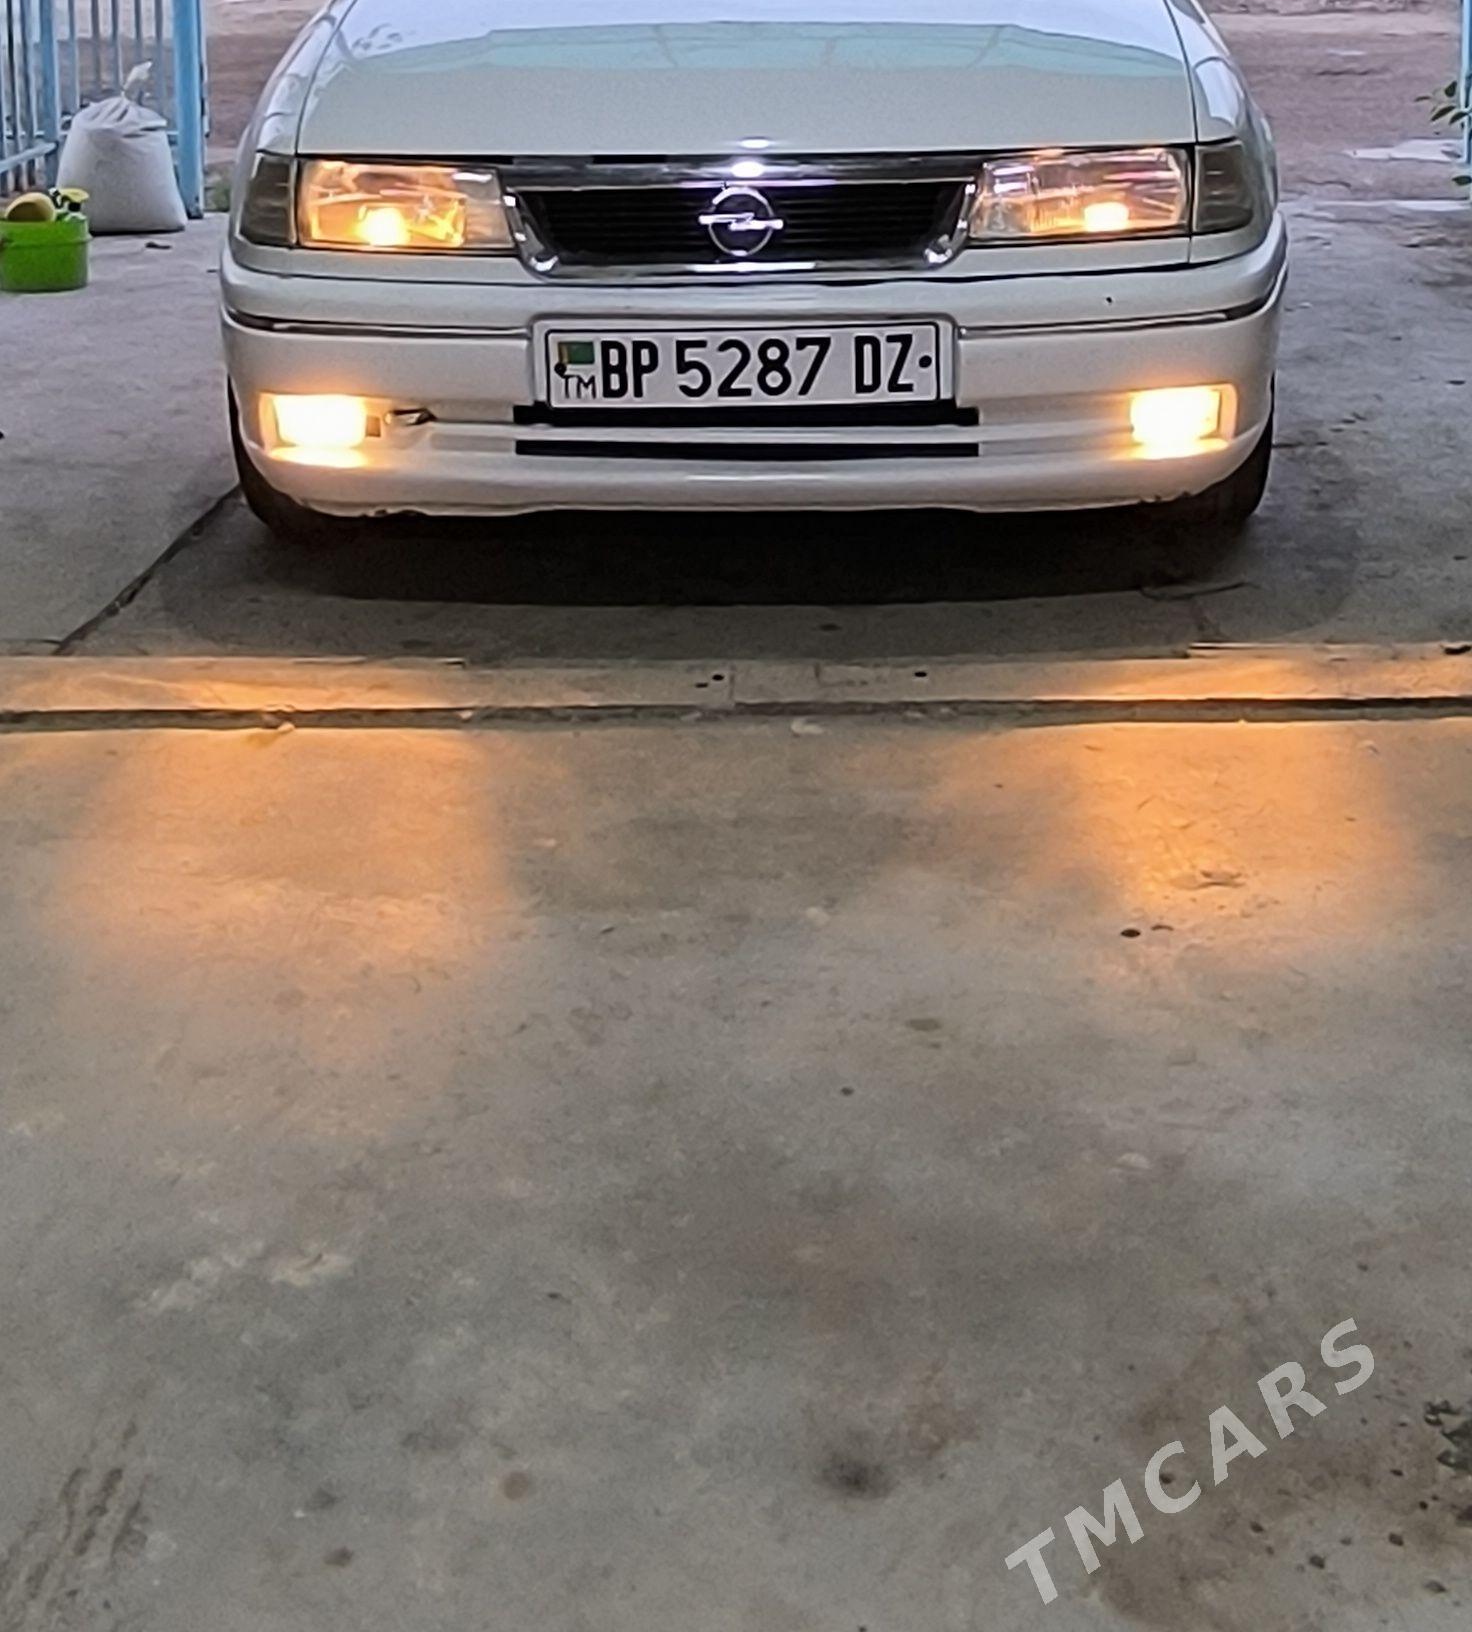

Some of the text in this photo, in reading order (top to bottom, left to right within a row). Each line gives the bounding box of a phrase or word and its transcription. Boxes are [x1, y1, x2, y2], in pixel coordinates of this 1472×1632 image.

[562, 374, 597, 399] TM
[600, 334, 914, 398] BP 5287 DZ
